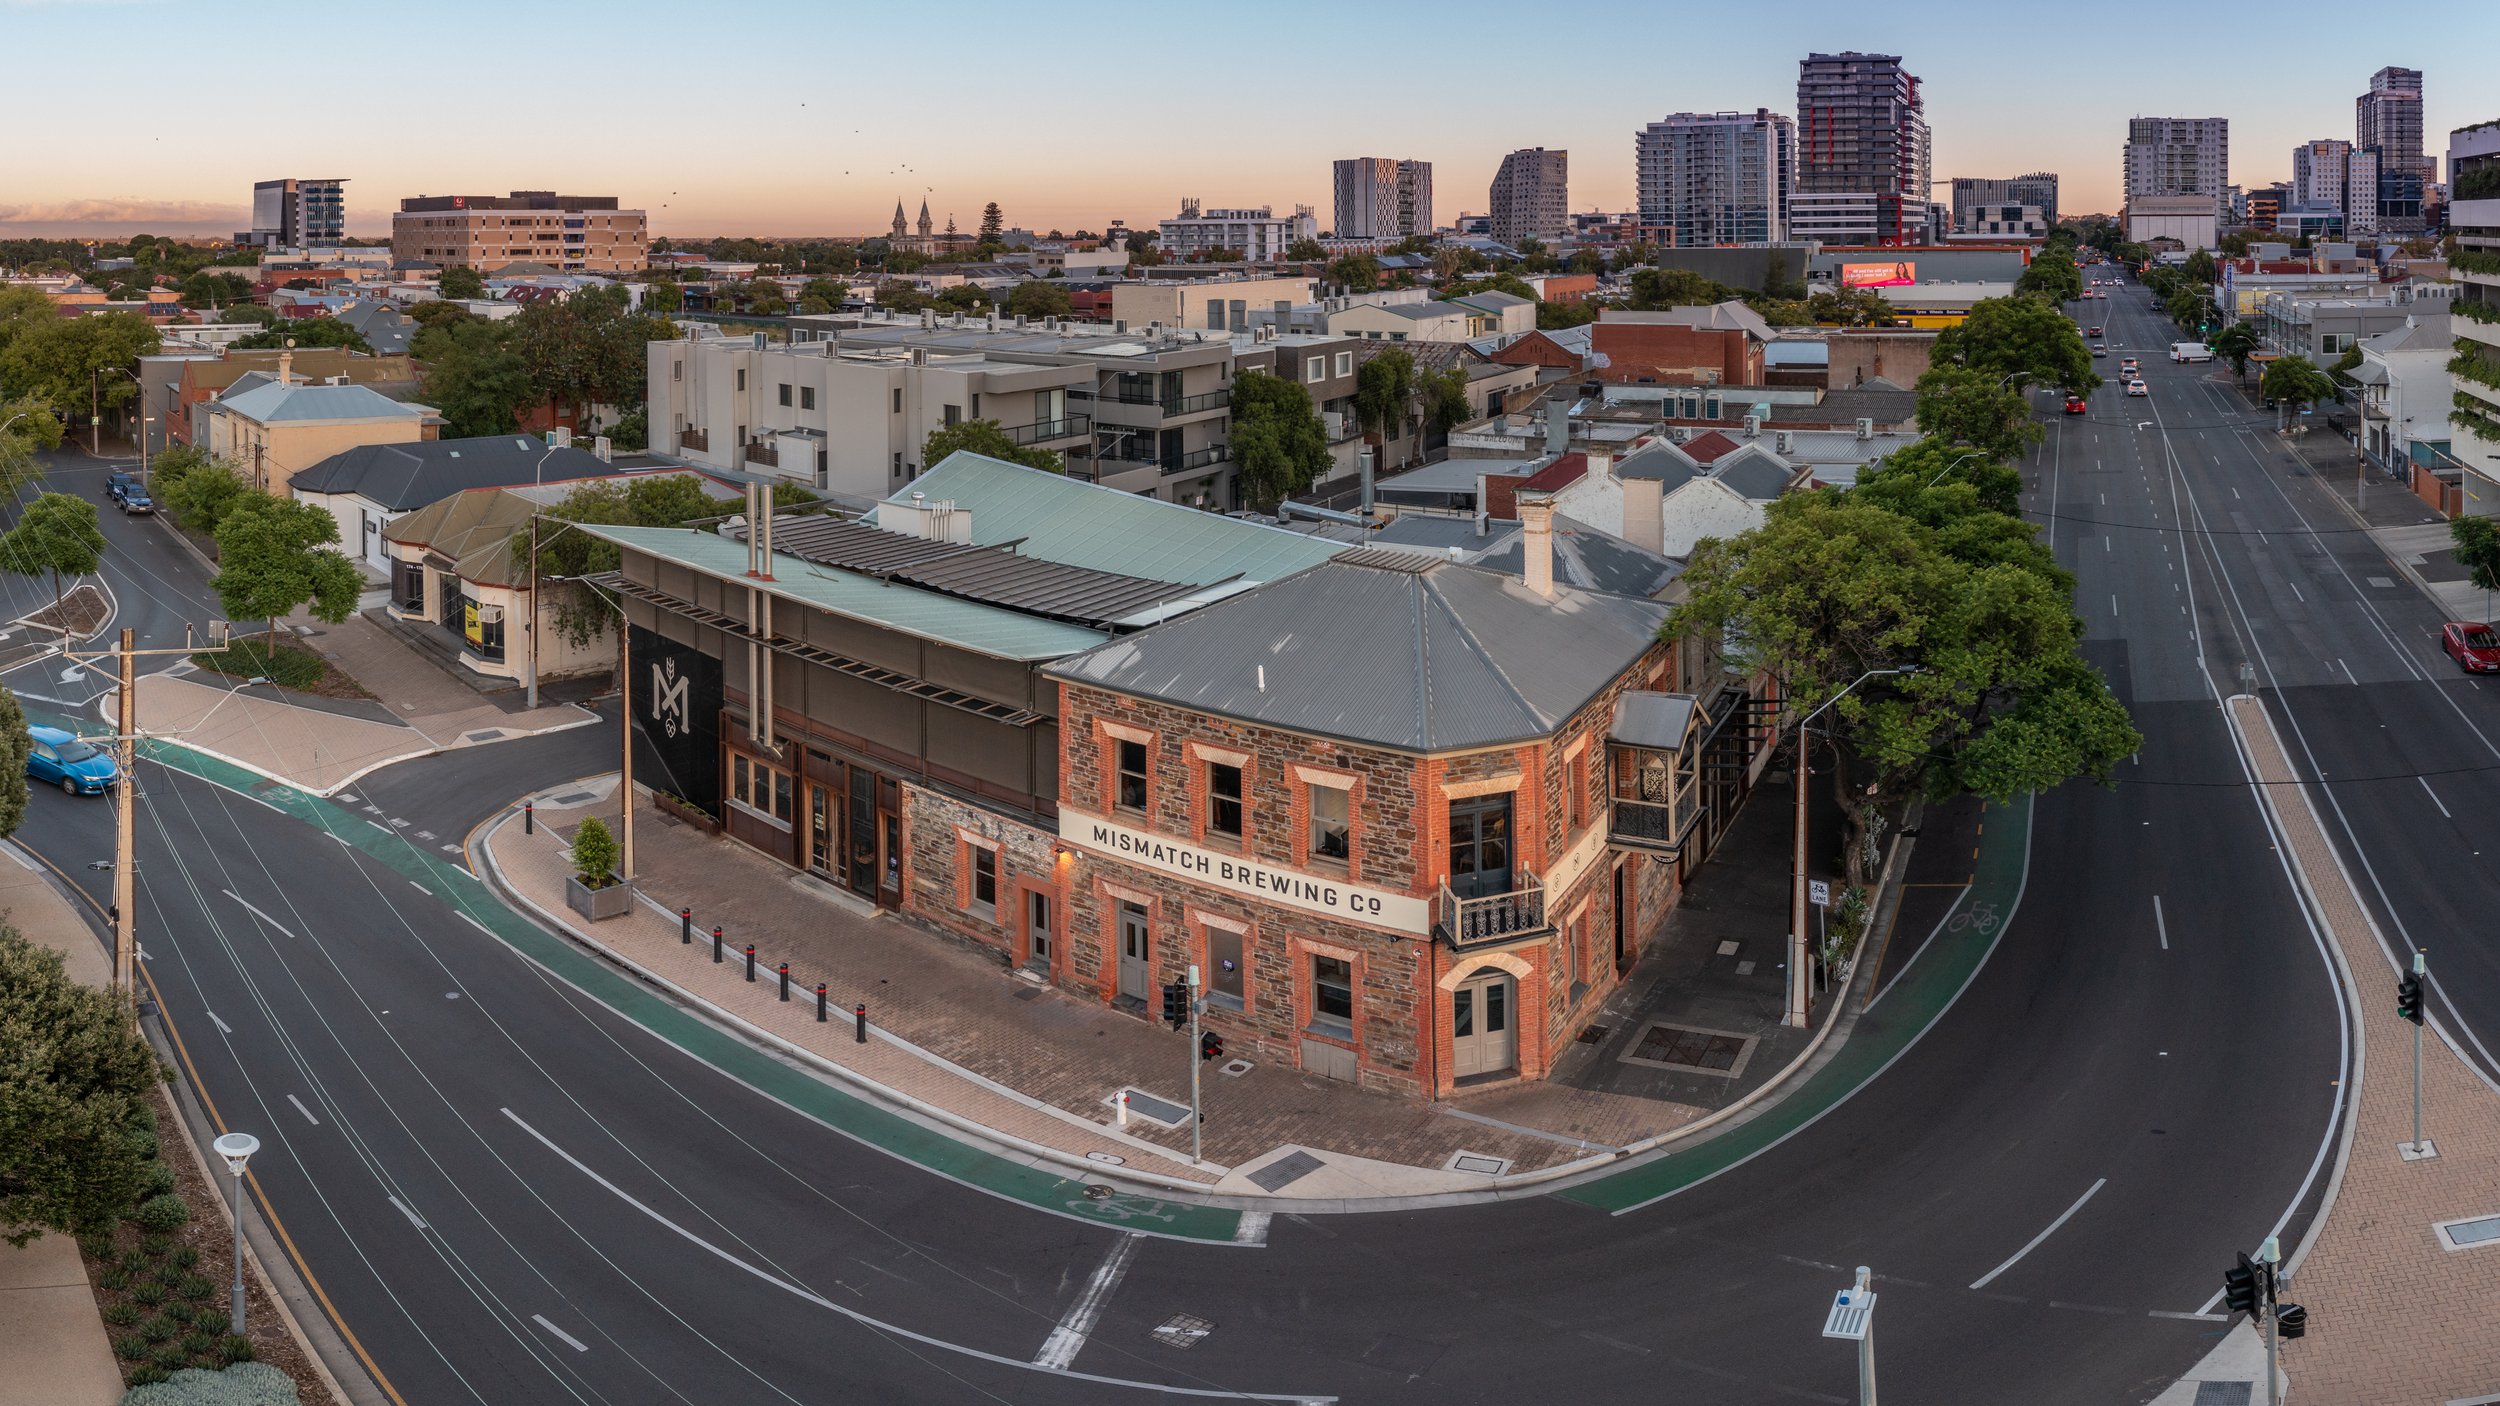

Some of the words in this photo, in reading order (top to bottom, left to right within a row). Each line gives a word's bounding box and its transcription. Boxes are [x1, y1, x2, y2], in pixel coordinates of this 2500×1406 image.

[1093, 825, 1209, 874] MISMATCH
[1221, 861, 1337, 906] BREWING
[1812, 894, 1827, 903] LANE
